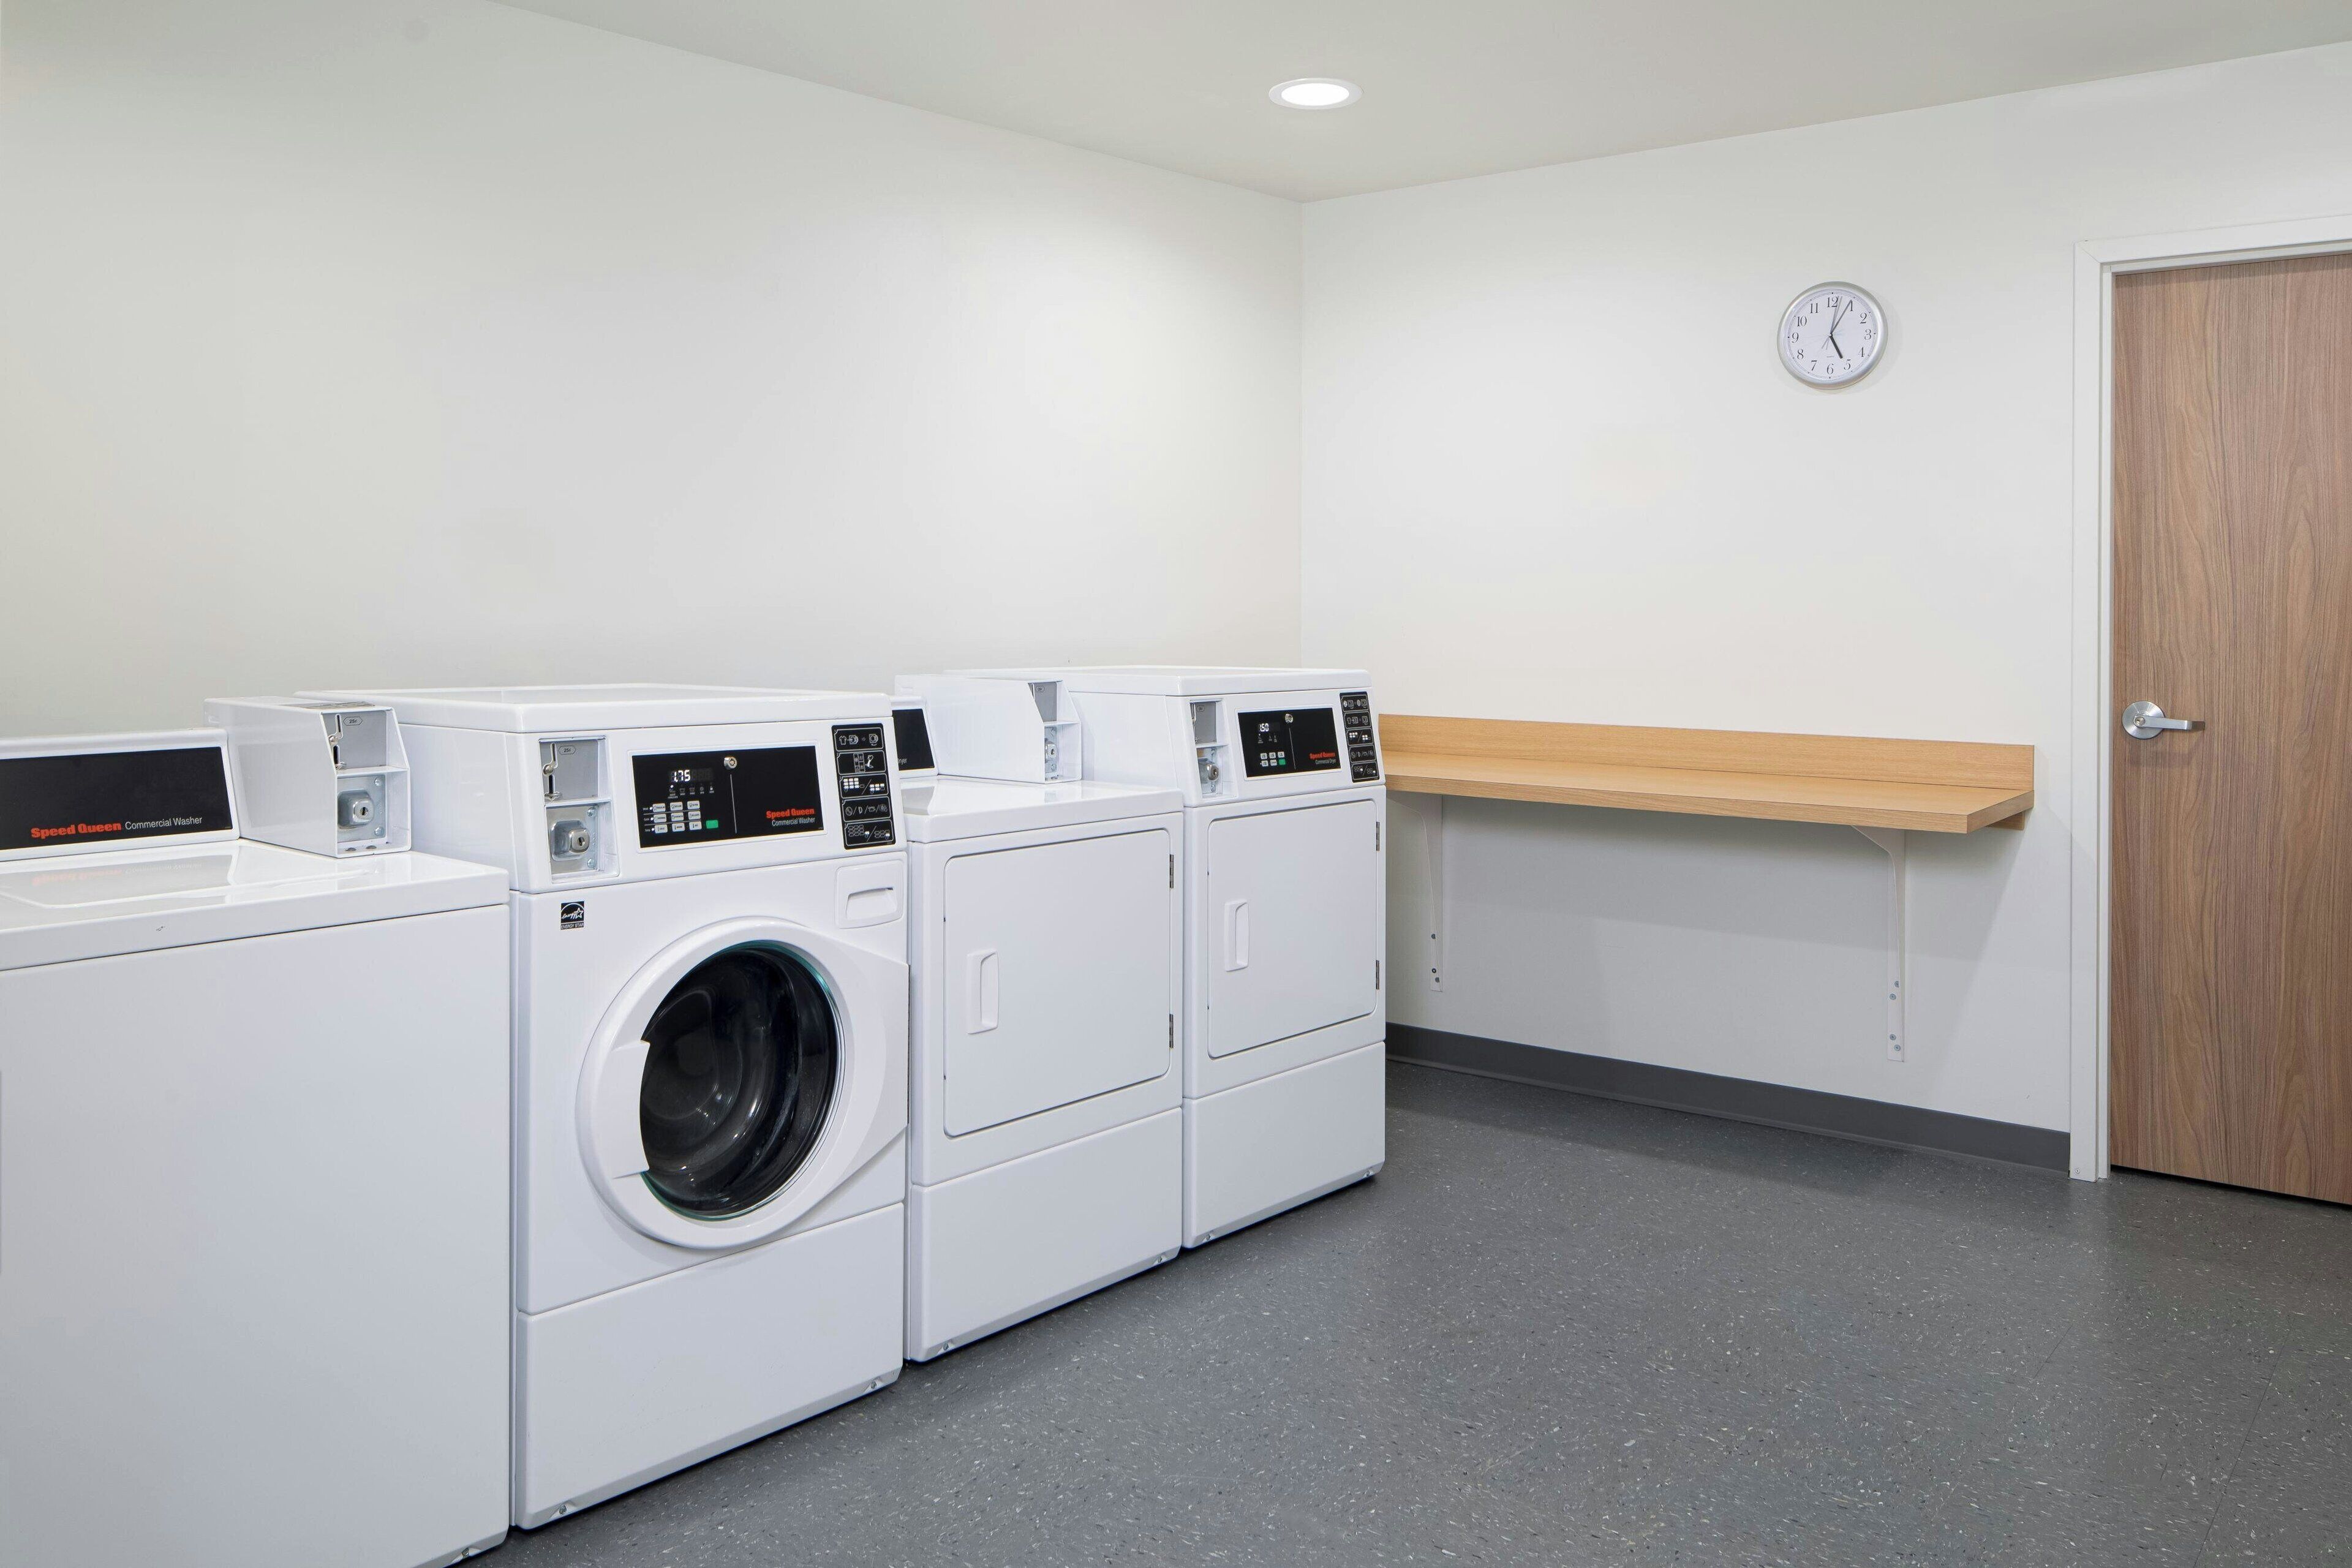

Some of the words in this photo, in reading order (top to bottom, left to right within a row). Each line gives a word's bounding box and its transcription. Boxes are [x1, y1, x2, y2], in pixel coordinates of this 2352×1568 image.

[1827, 296, 1838, 307] 12
[1810, 303, 1819, 314] 11
[1796, 316, 1807, 327] 10
[1860, 312, 1867, 324] 2
[1792, 332, 1799, 343] 9
[1864, 329, 1872, 340] 3
[1797, 349, 1804, 360] 8
[1858, 347, 1865, 357] 4
[1811, 360, 1817, 371] 7
[1826, 363, 1834, 374] 6
[1844, 359, 1851, 371] 5
[766, 809, 790, 820] Speed
[31, 824, 76, 839] Speed
[77, 822, 122, 834] Queen
[125, 818, 172, 830] Commercial
[173, 816, 203, 826] Washer
[772, 817, 798, 827] Commercial
